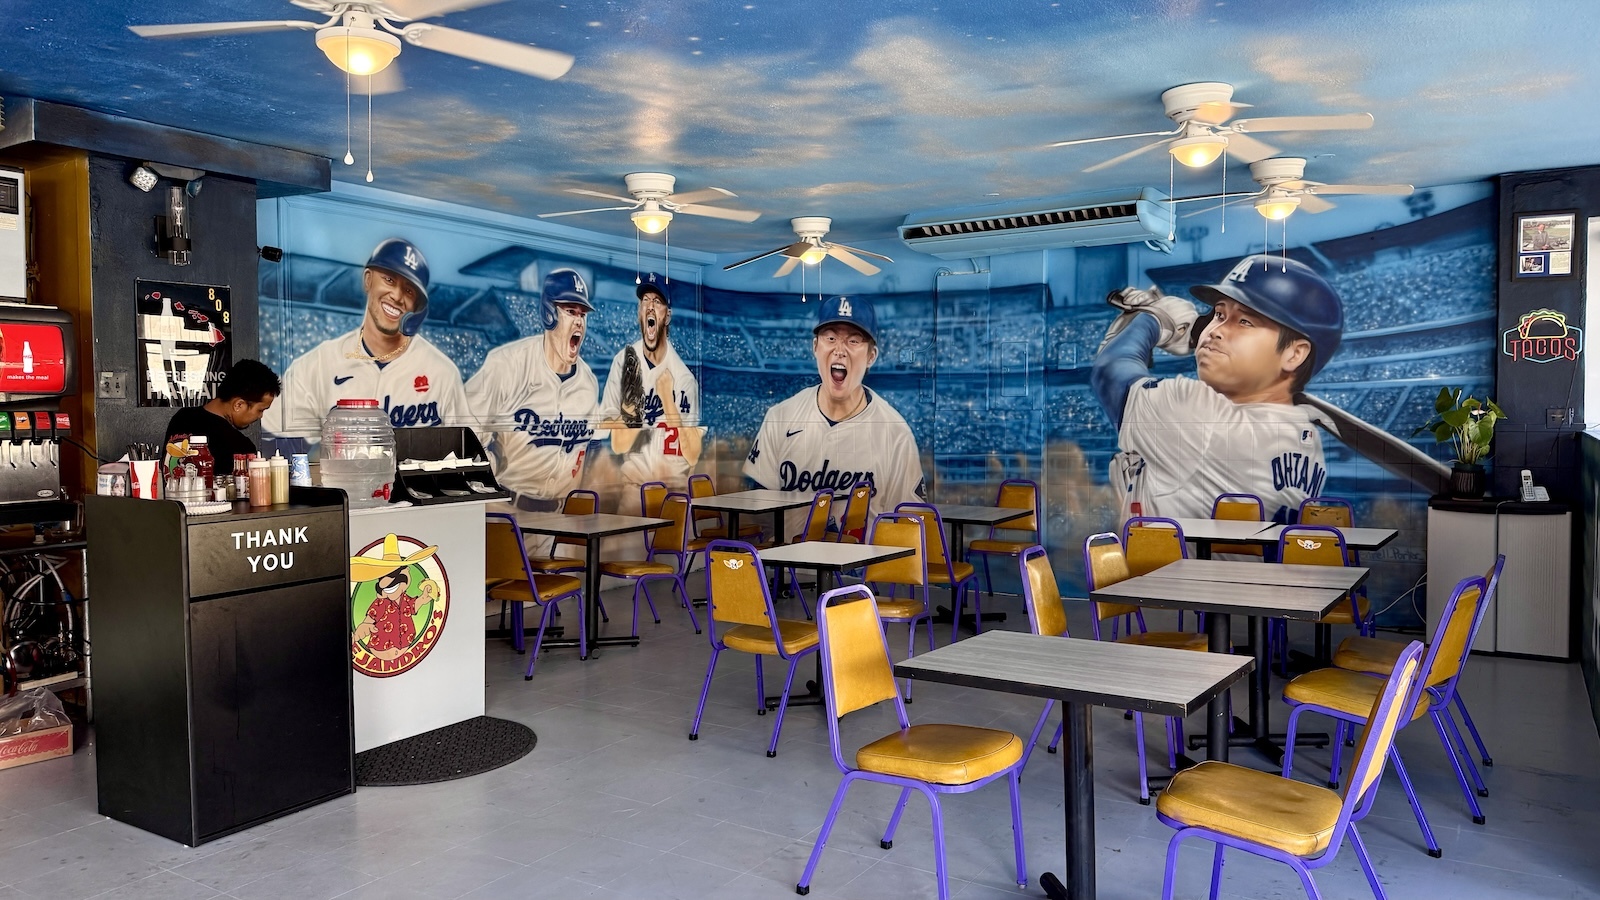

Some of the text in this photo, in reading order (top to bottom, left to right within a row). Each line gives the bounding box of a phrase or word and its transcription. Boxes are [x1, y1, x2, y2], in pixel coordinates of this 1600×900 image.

[403, 246, 418, 270] LA
[838, 297, 853, 317] LA
[1509, 337, 1577, 362] TACOS
[680, 390, 691, 414] LA
[571, 450, 586, 479] 5
[1270, 452, 1326, 502] OHTANI
[231, 526, 309, 549] THANK
[247, 552, 295, 574] YOU
